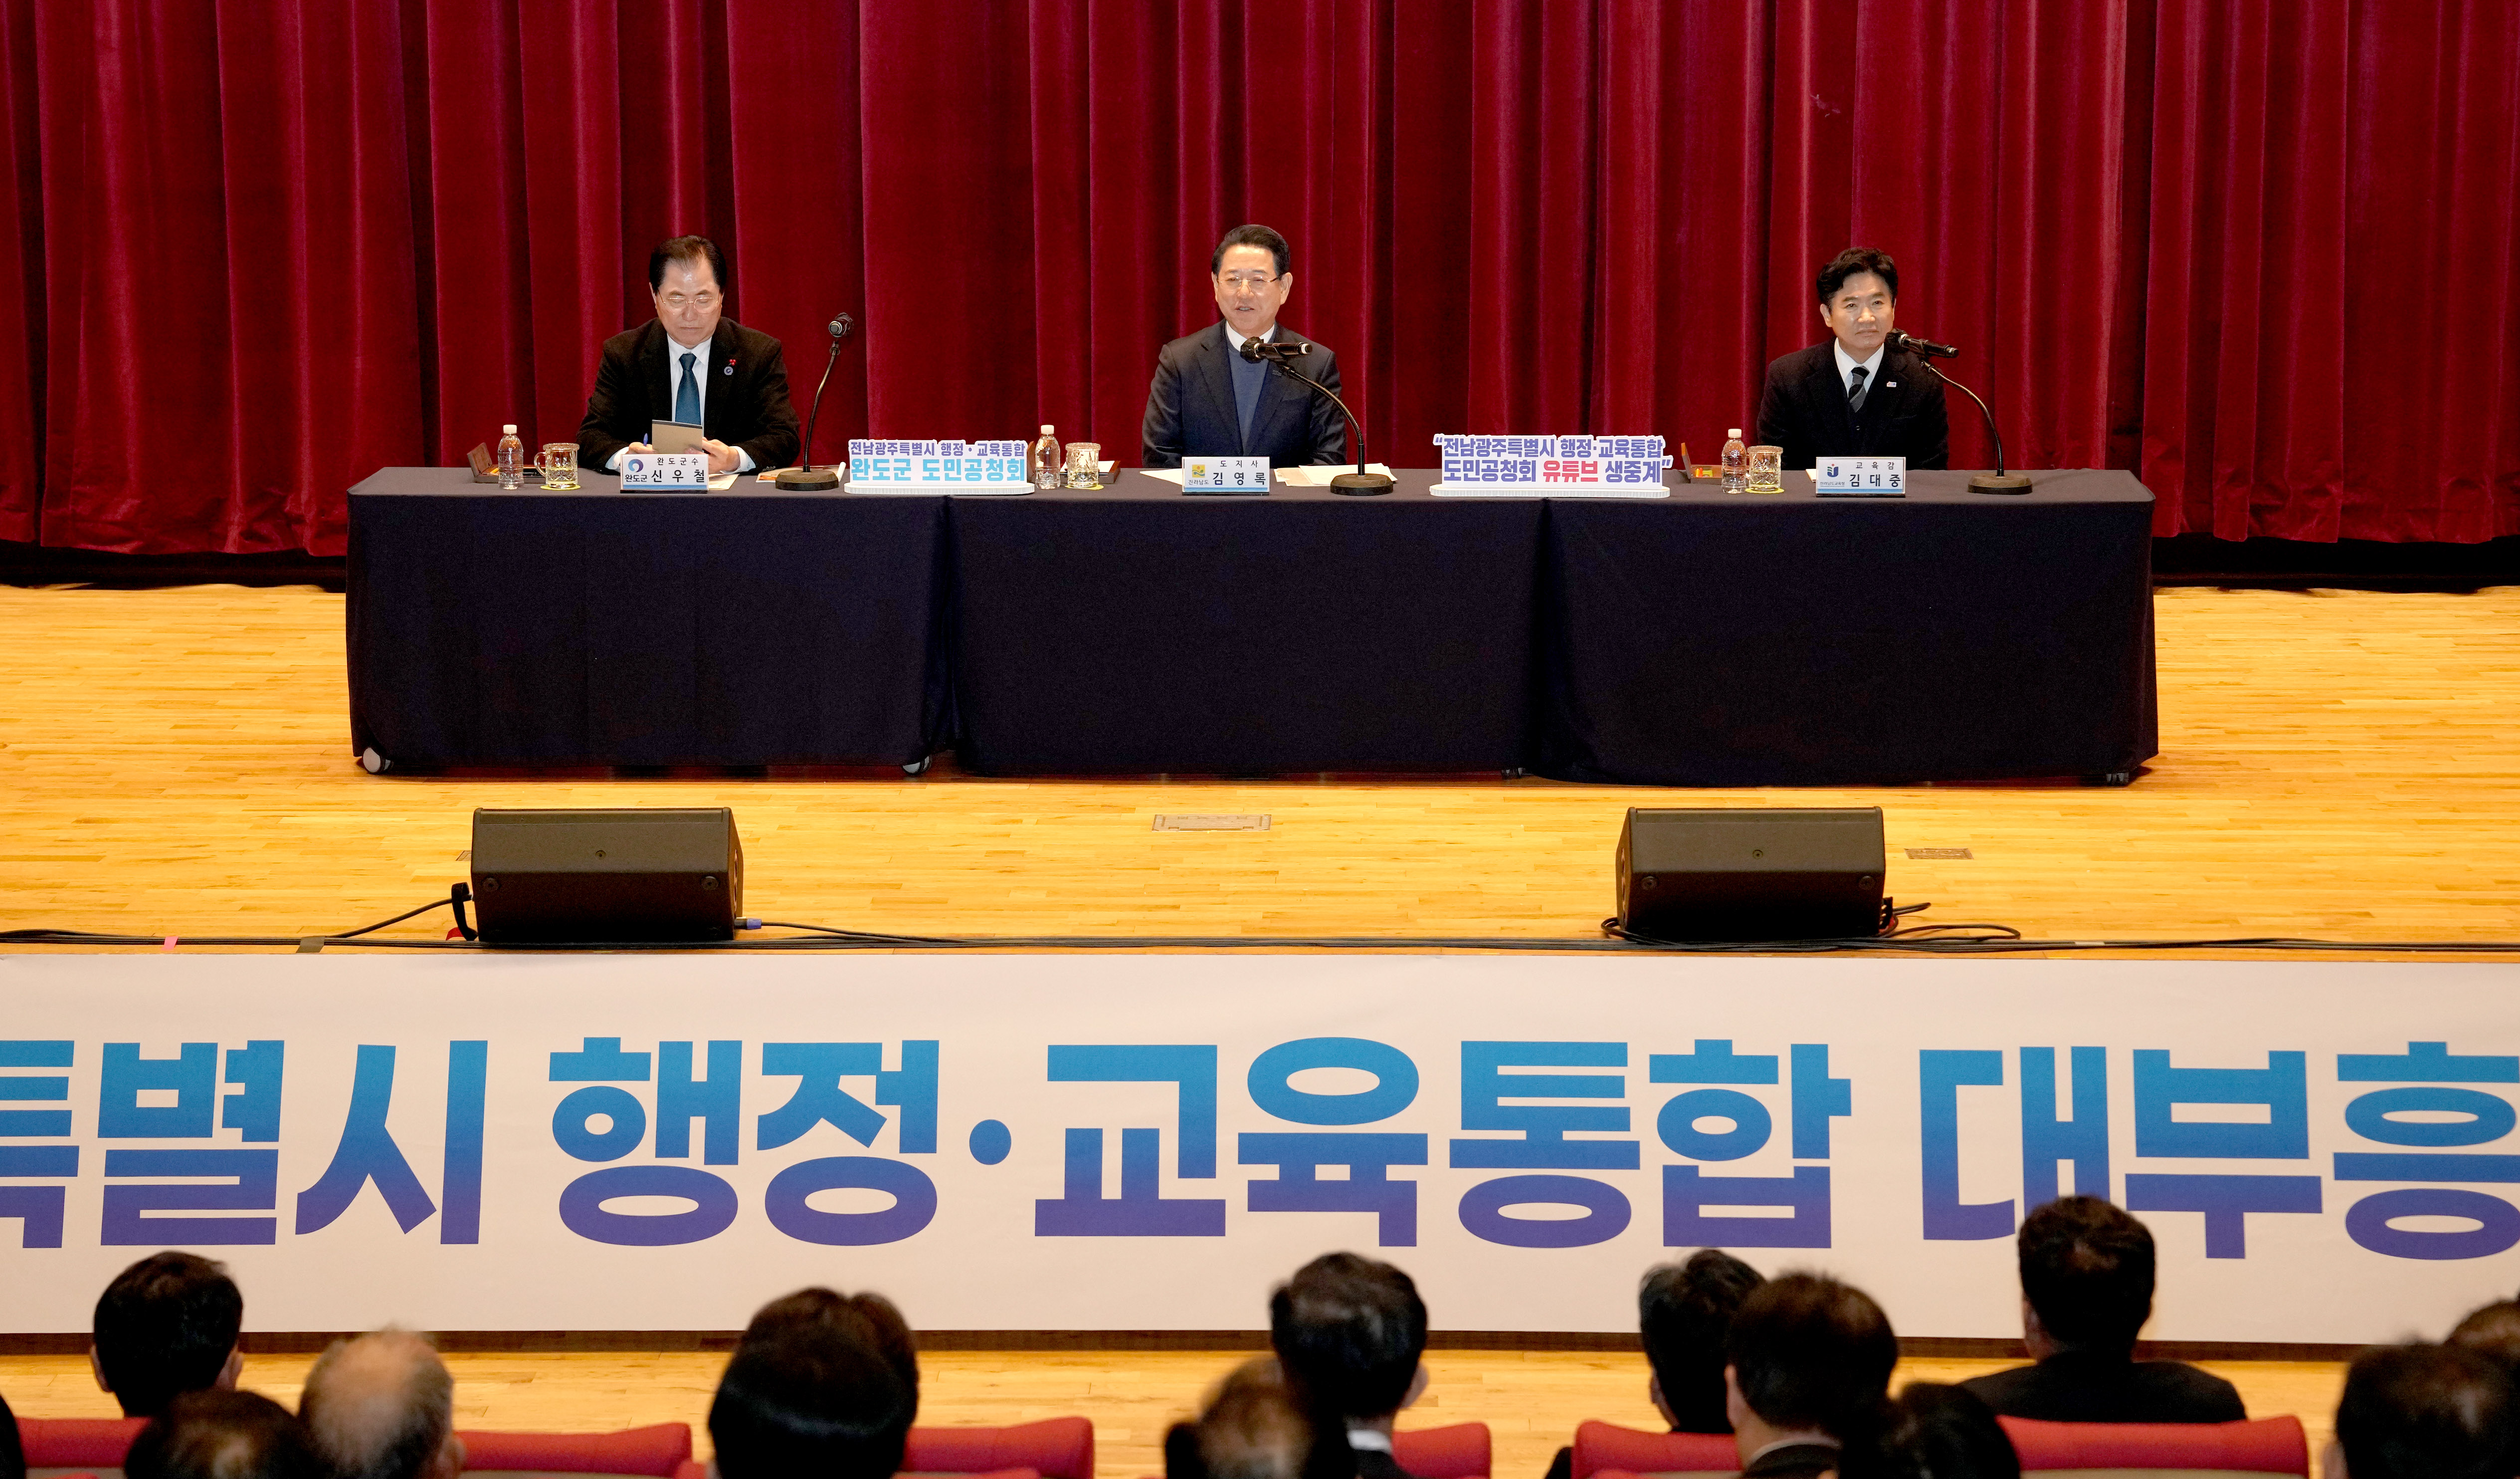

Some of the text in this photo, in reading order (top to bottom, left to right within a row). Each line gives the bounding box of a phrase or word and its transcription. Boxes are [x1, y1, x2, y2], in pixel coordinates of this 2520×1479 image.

[851, 442, 935, 456] 전남광주특별시
[851, 458, 1025, 482] 완도군 도민공청회
[1444, 459, 1536, 482] 도민공청회
[1543, 460, 1598, 483] 유튜브
[1920, 1042, 2520, 1259] 대부흥
